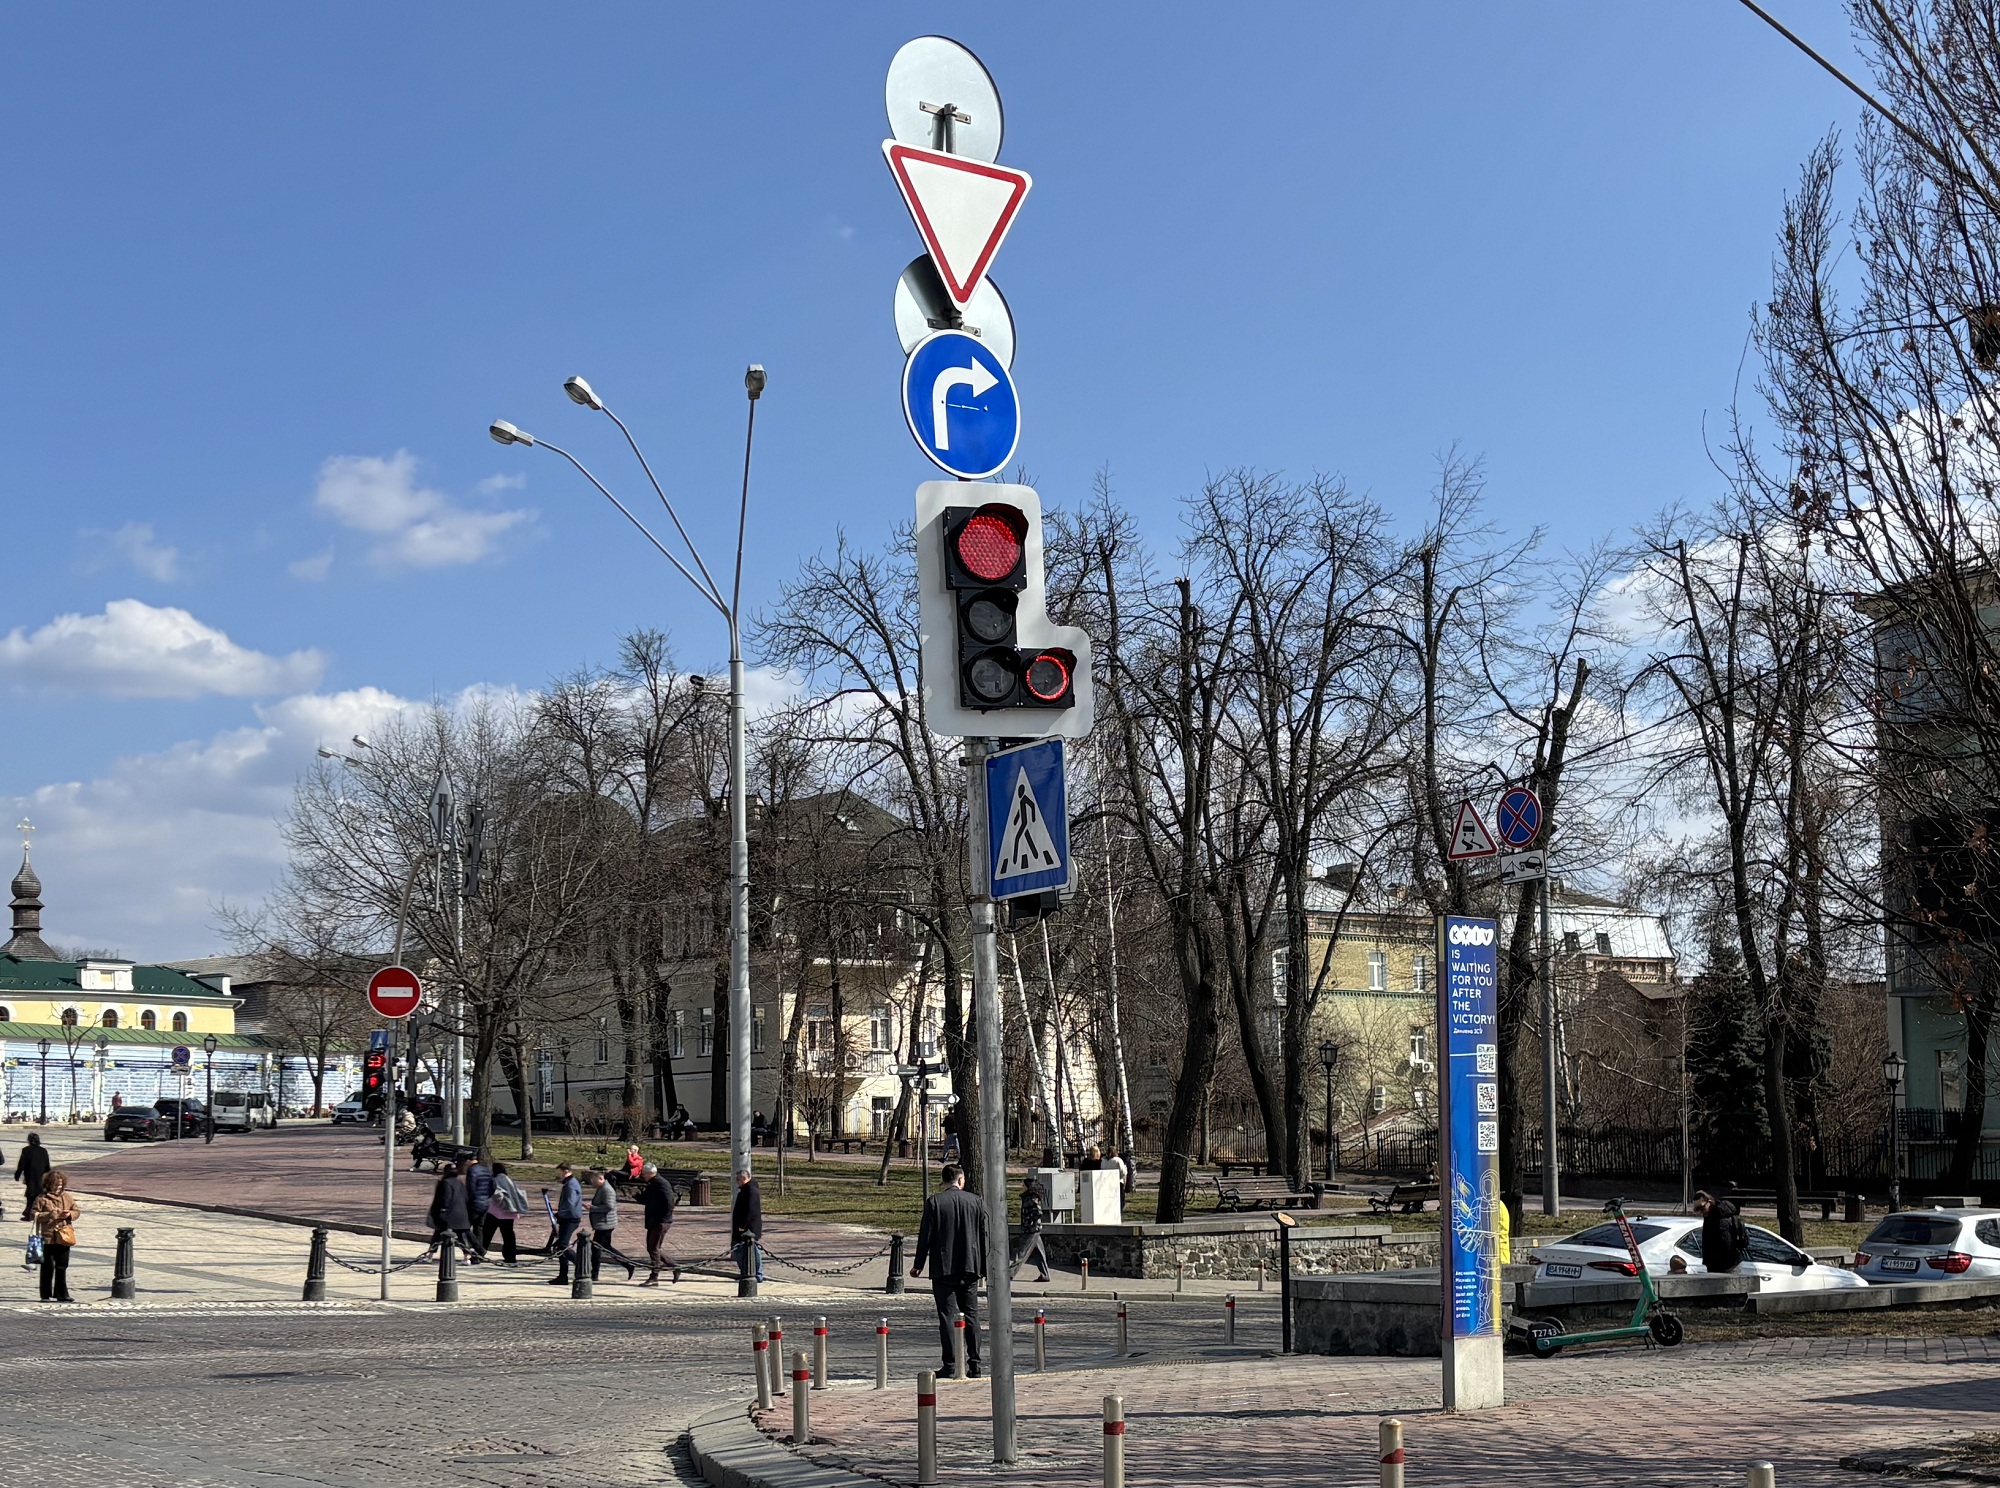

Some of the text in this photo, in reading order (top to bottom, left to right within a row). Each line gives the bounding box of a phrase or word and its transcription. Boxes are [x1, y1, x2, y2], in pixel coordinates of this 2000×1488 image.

[1451, 949, 1461, 959] IS
[1451, 962, 1491, 974] WAITING
[1452, 974, 1493, 987] FOR YOU
[1452, 987, 1482, 999] AFTER
[1452, 1000, 1471, 1011] THE
[1452, 1013, 1495, 1025] VICTORY!
[1531, 1328, 1557, 1338] T2743
